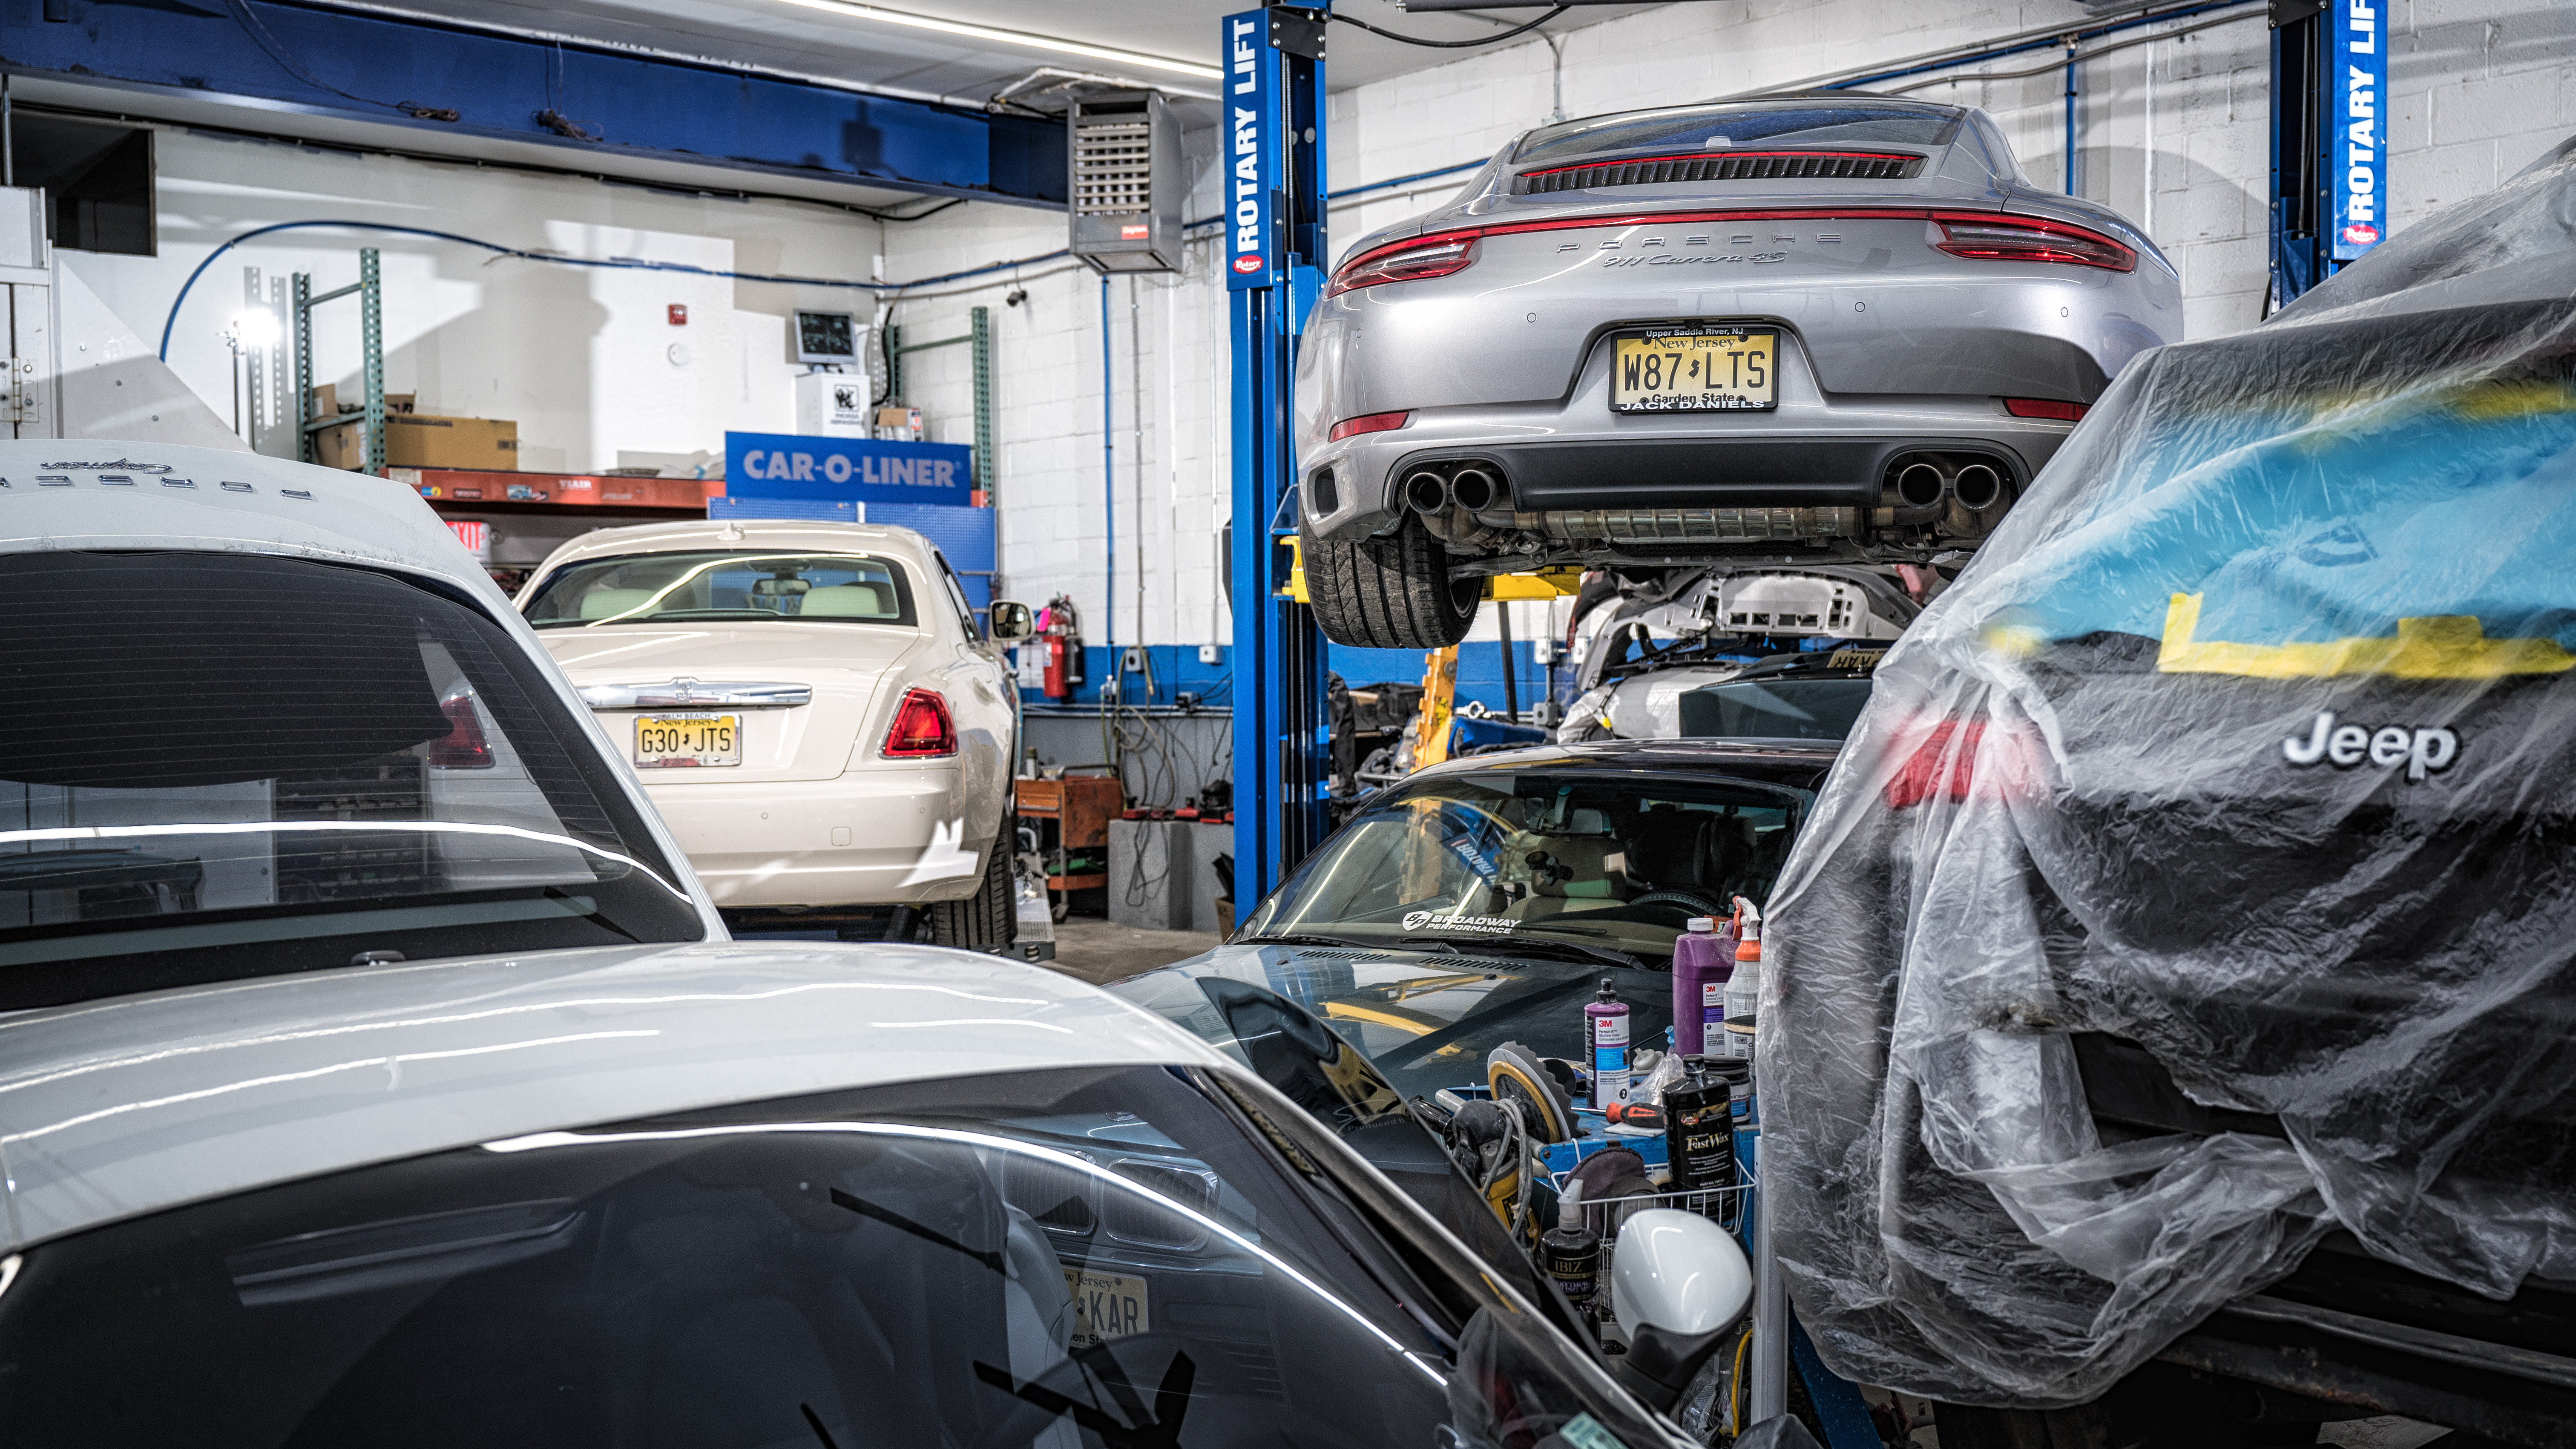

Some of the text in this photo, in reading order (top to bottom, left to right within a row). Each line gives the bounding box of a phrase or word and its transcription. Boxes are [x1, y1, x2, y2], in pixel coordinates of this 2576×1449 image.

[2349, 0, 2375, 221] ROTARY LIF
[1233, 20, 1259, 253] ROTARY LIFT
[1557, 233, 1841, 253] PORSCHE
[1235, 259, 1262, 272] Rotary
[1603, 251, 1788, 267] 911 Carrera 4S
[1646, 330, 1672, 338] Upper
[1706, 328, 1730, 336] River,
[1653, 338, 1736, 351] New Jersey
[1624, 351, 1765, 391] W87 LTS
[1621, 400, 1765, 411] JACK DANIELS
[1652, 392, 1735, 404] Garden State
[40, 458, 172, 474] Cayman
[642, 728, 730, 753] G30 JTS
[2283, 712, 2458, 780] Jeep
[1426, 923, 1512, 934] PERFORMANCE
[1431, 915, 1522, 927] BROADWAY
[1348, 1118, 1397, 1131] Produced
[1555, 1261, 1583, 1272] IBIZ
[1076, 1271, 1113, 1291] Jersey
[1090, 1290, 1139, 1337] KAR
